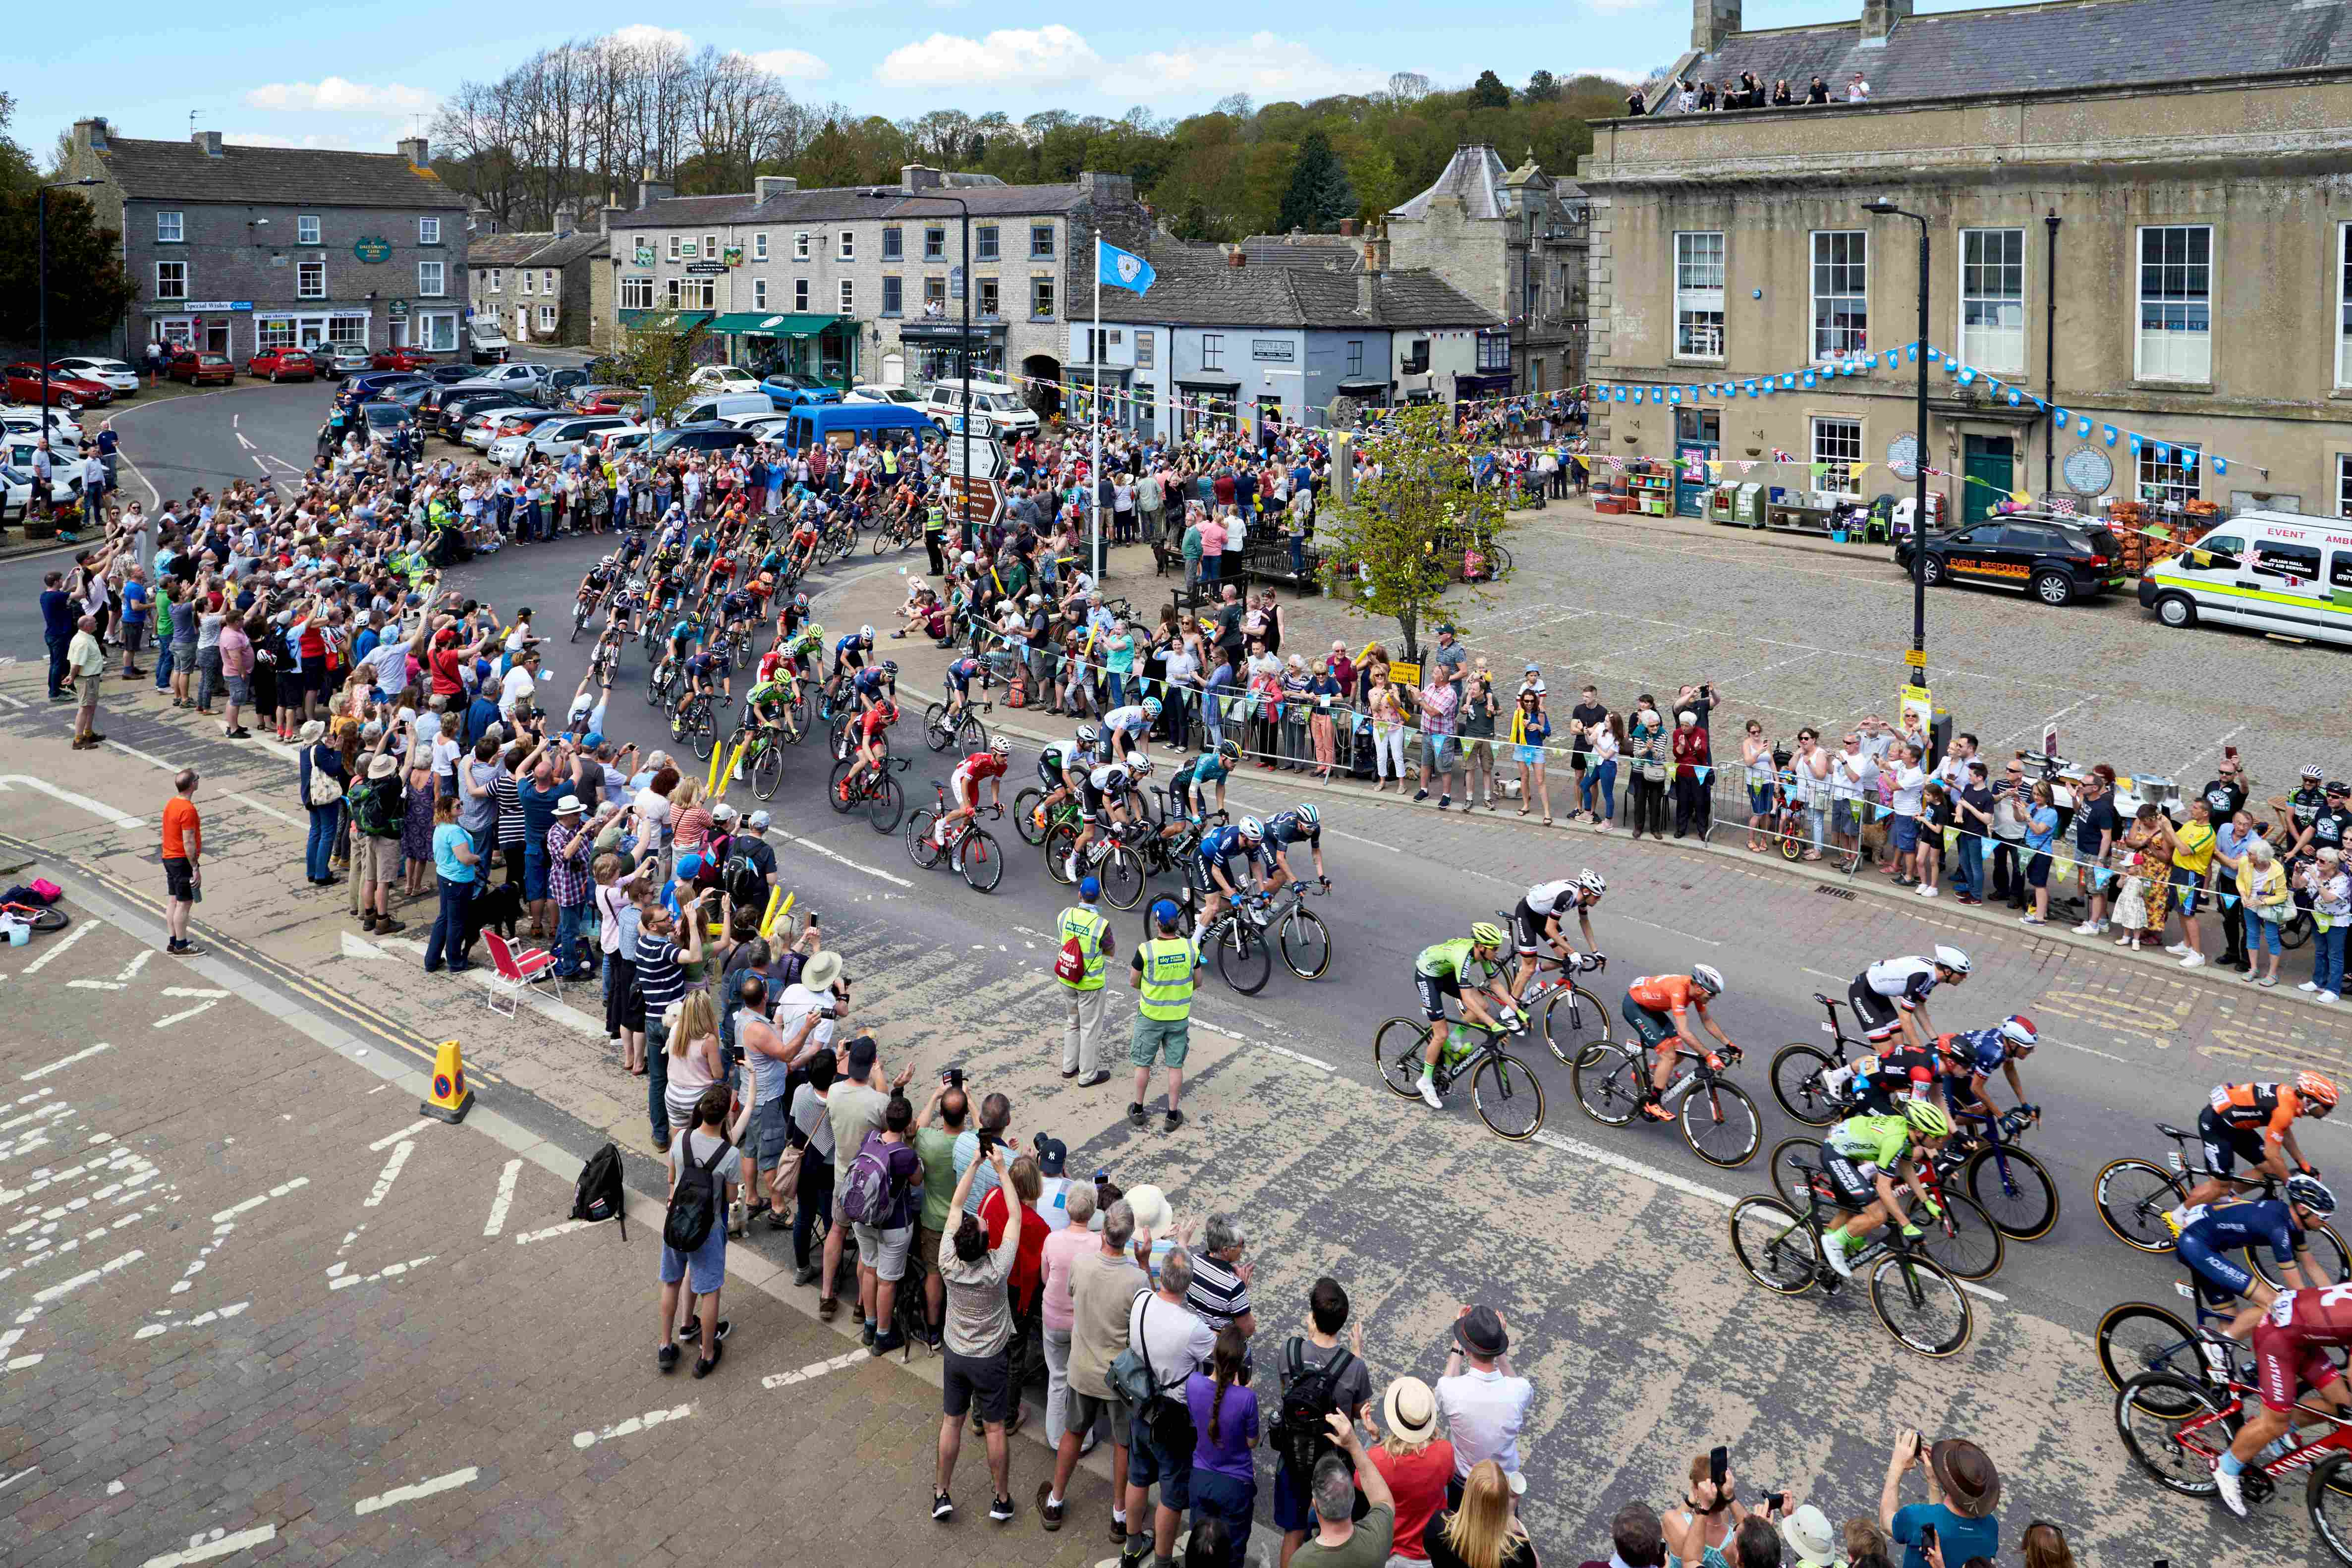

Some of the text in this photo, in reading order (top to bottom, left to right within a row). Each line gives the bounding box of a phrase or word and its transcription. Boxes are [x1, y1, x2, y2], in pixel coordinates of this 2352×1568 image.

[2267, 528, 2306, 539] EVENT
[1950, 558, 2030, 574] EVENT RESPONDER
[2285, 564, 2312, 573] SERVICES
[1197, 855, 1210, 887] CANYON
[1202, 919, 1229, 942] CANYON
[1426, 959, 1451, 970] ORBEA
[1634, 1018, 1657, 1042] RALLY
[1452, 1046, 1487, 1076] ORBEA
[1885, 1065, 1906, 1075] BMC
[2266, 1353, 2284, 1401] KATUSHA
[2265, 1444, 2332, 1477] CANYON
